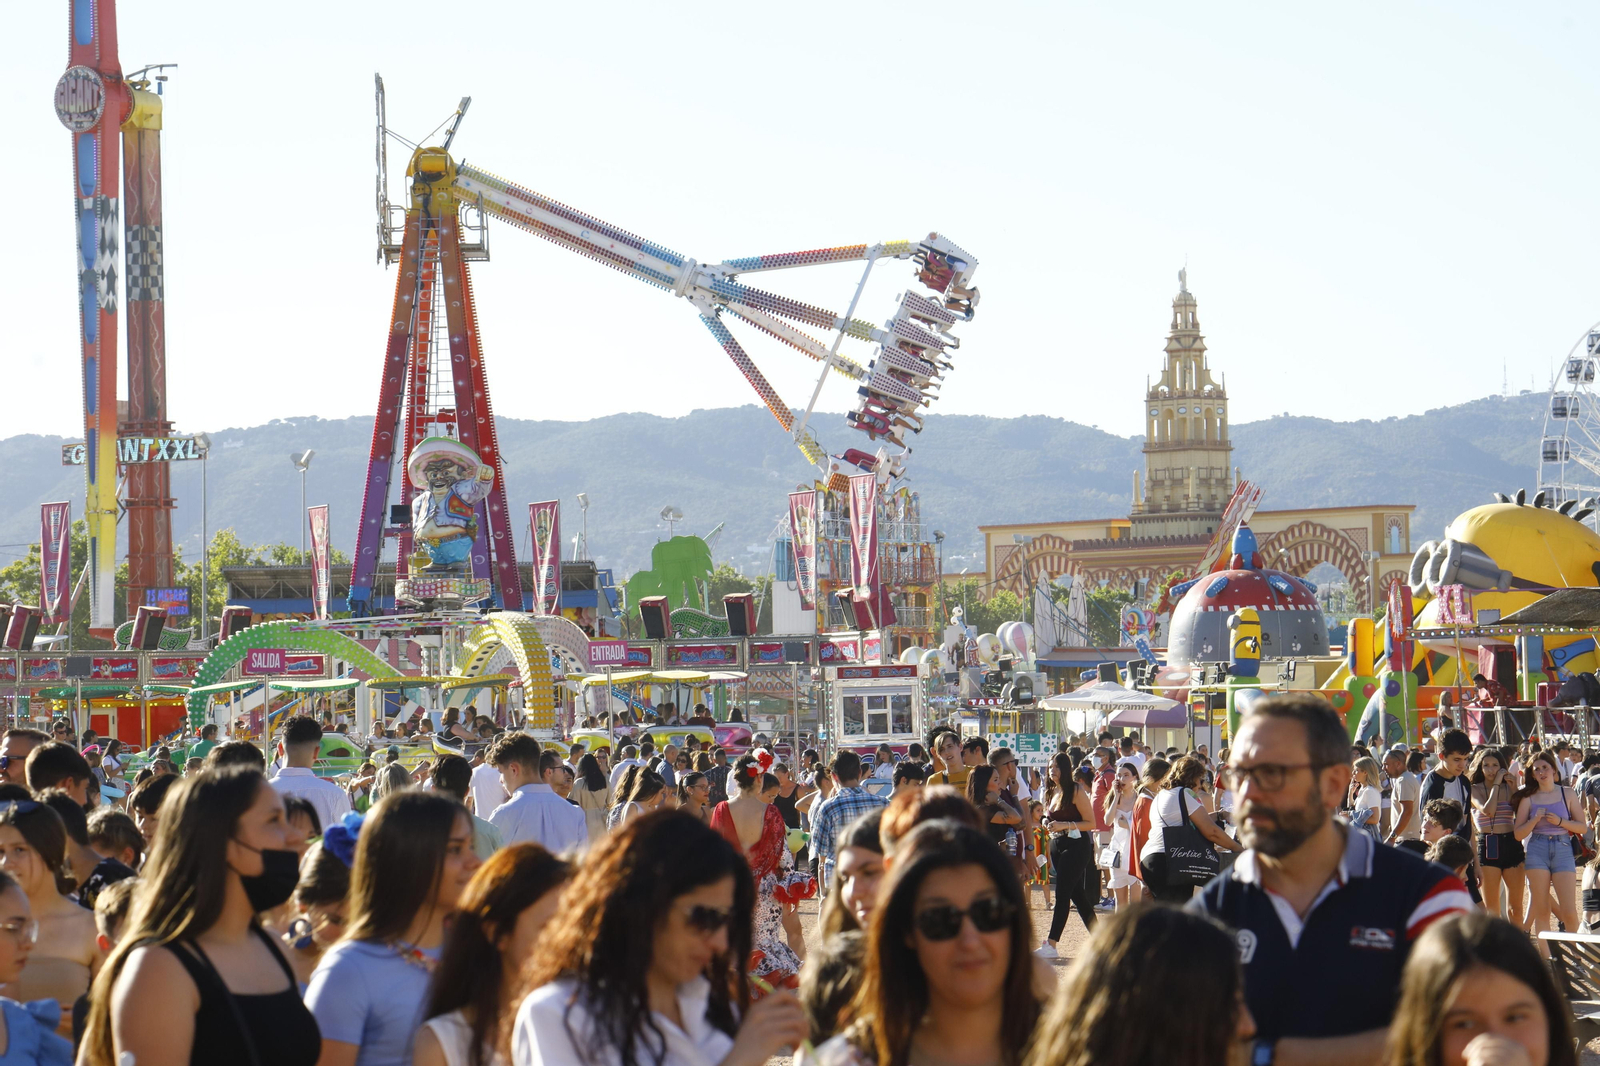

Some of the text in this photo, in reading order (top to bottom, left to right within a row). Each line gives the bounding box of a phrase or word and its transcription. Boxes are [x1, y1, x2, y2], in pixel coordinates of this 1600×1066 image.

[57, 78, 100, 113] GIGANT
[155, 439, 199, 460] XXL
[1433, 584, 1473, 624] XL
[251, 652, 281, 668] SALIDA
[591, 644, 626, 662] ENTRADA
[843, 667, 912, 678] ZIG ZAG
[1169, 846, 1202, 859] Vertize
